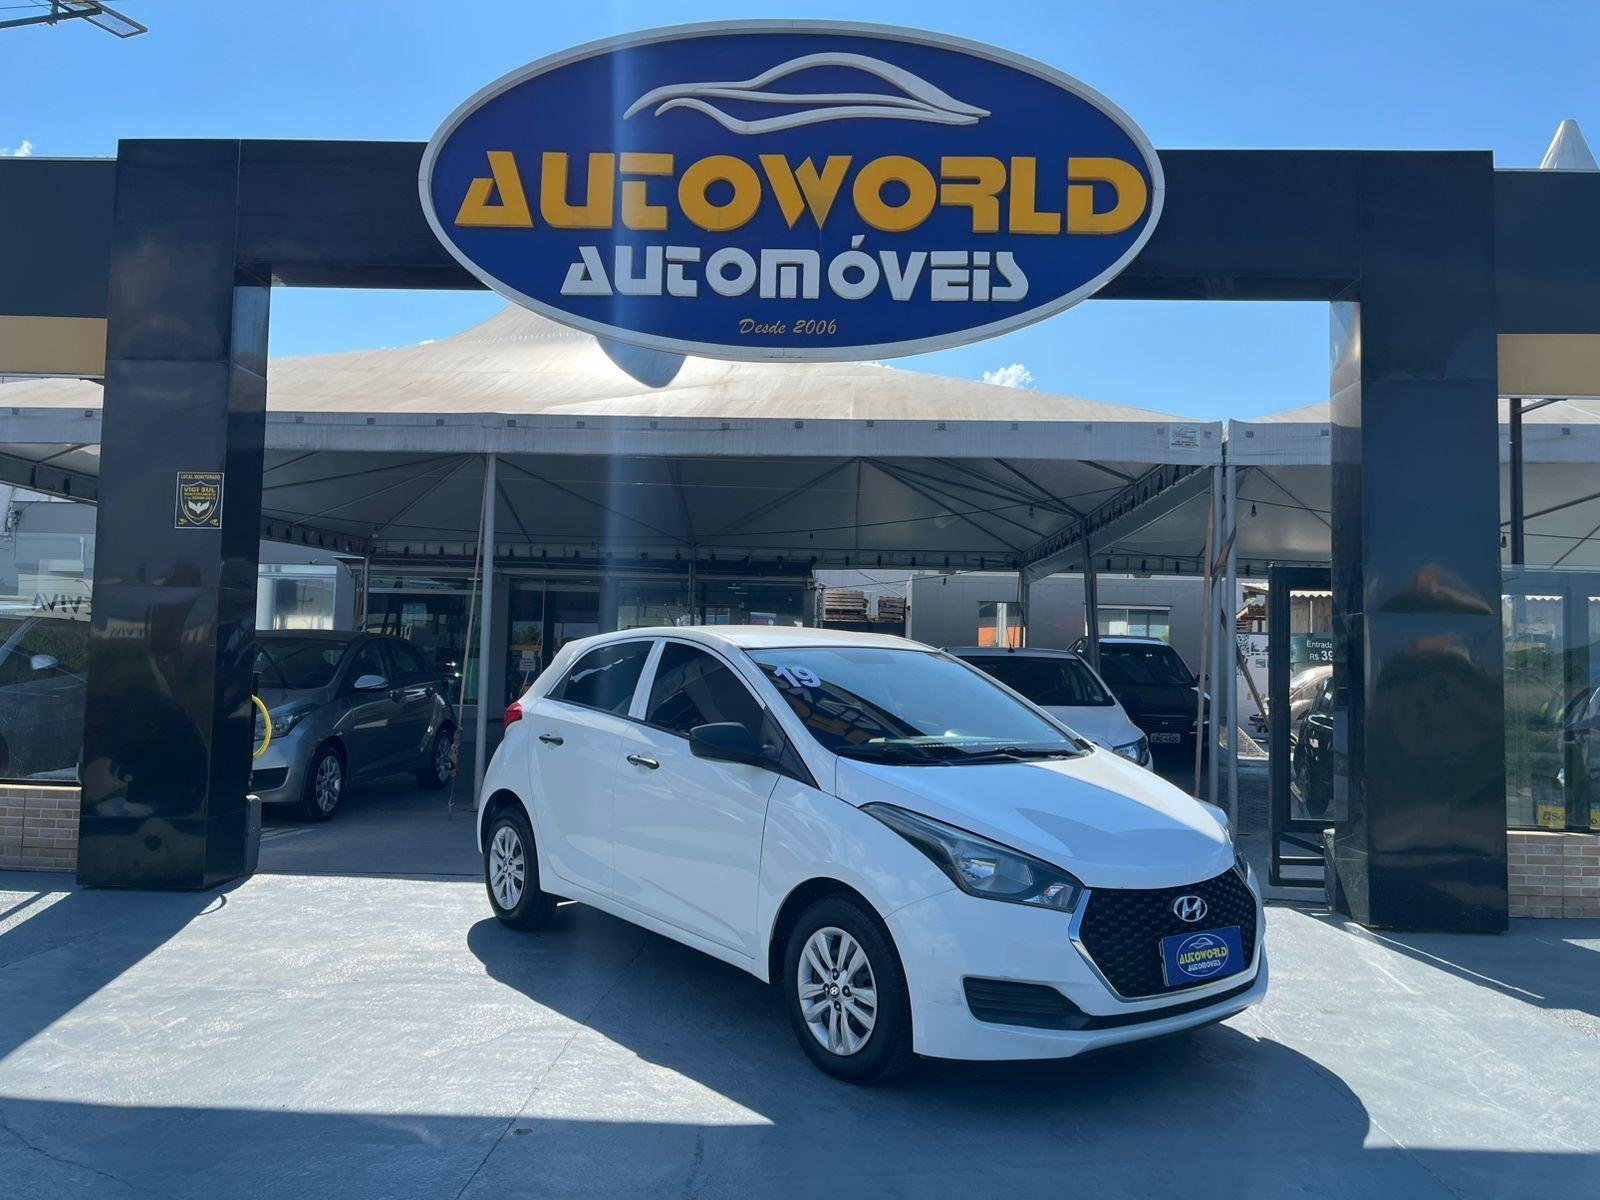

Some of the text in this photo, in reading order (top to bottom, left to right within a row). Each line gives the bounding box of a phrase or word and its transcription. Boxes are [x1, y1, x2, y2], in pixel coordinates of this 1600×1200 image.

[455, 150, 1147, 235] AUTOWORLD
[561, 234, 1029, 302] AUTOMÓVEIS
[739, 318, 837, 335] Desde 2006
[773, 666, 822, 688] 19
[1180, 947, 1227, 964] AUTOWORLD
